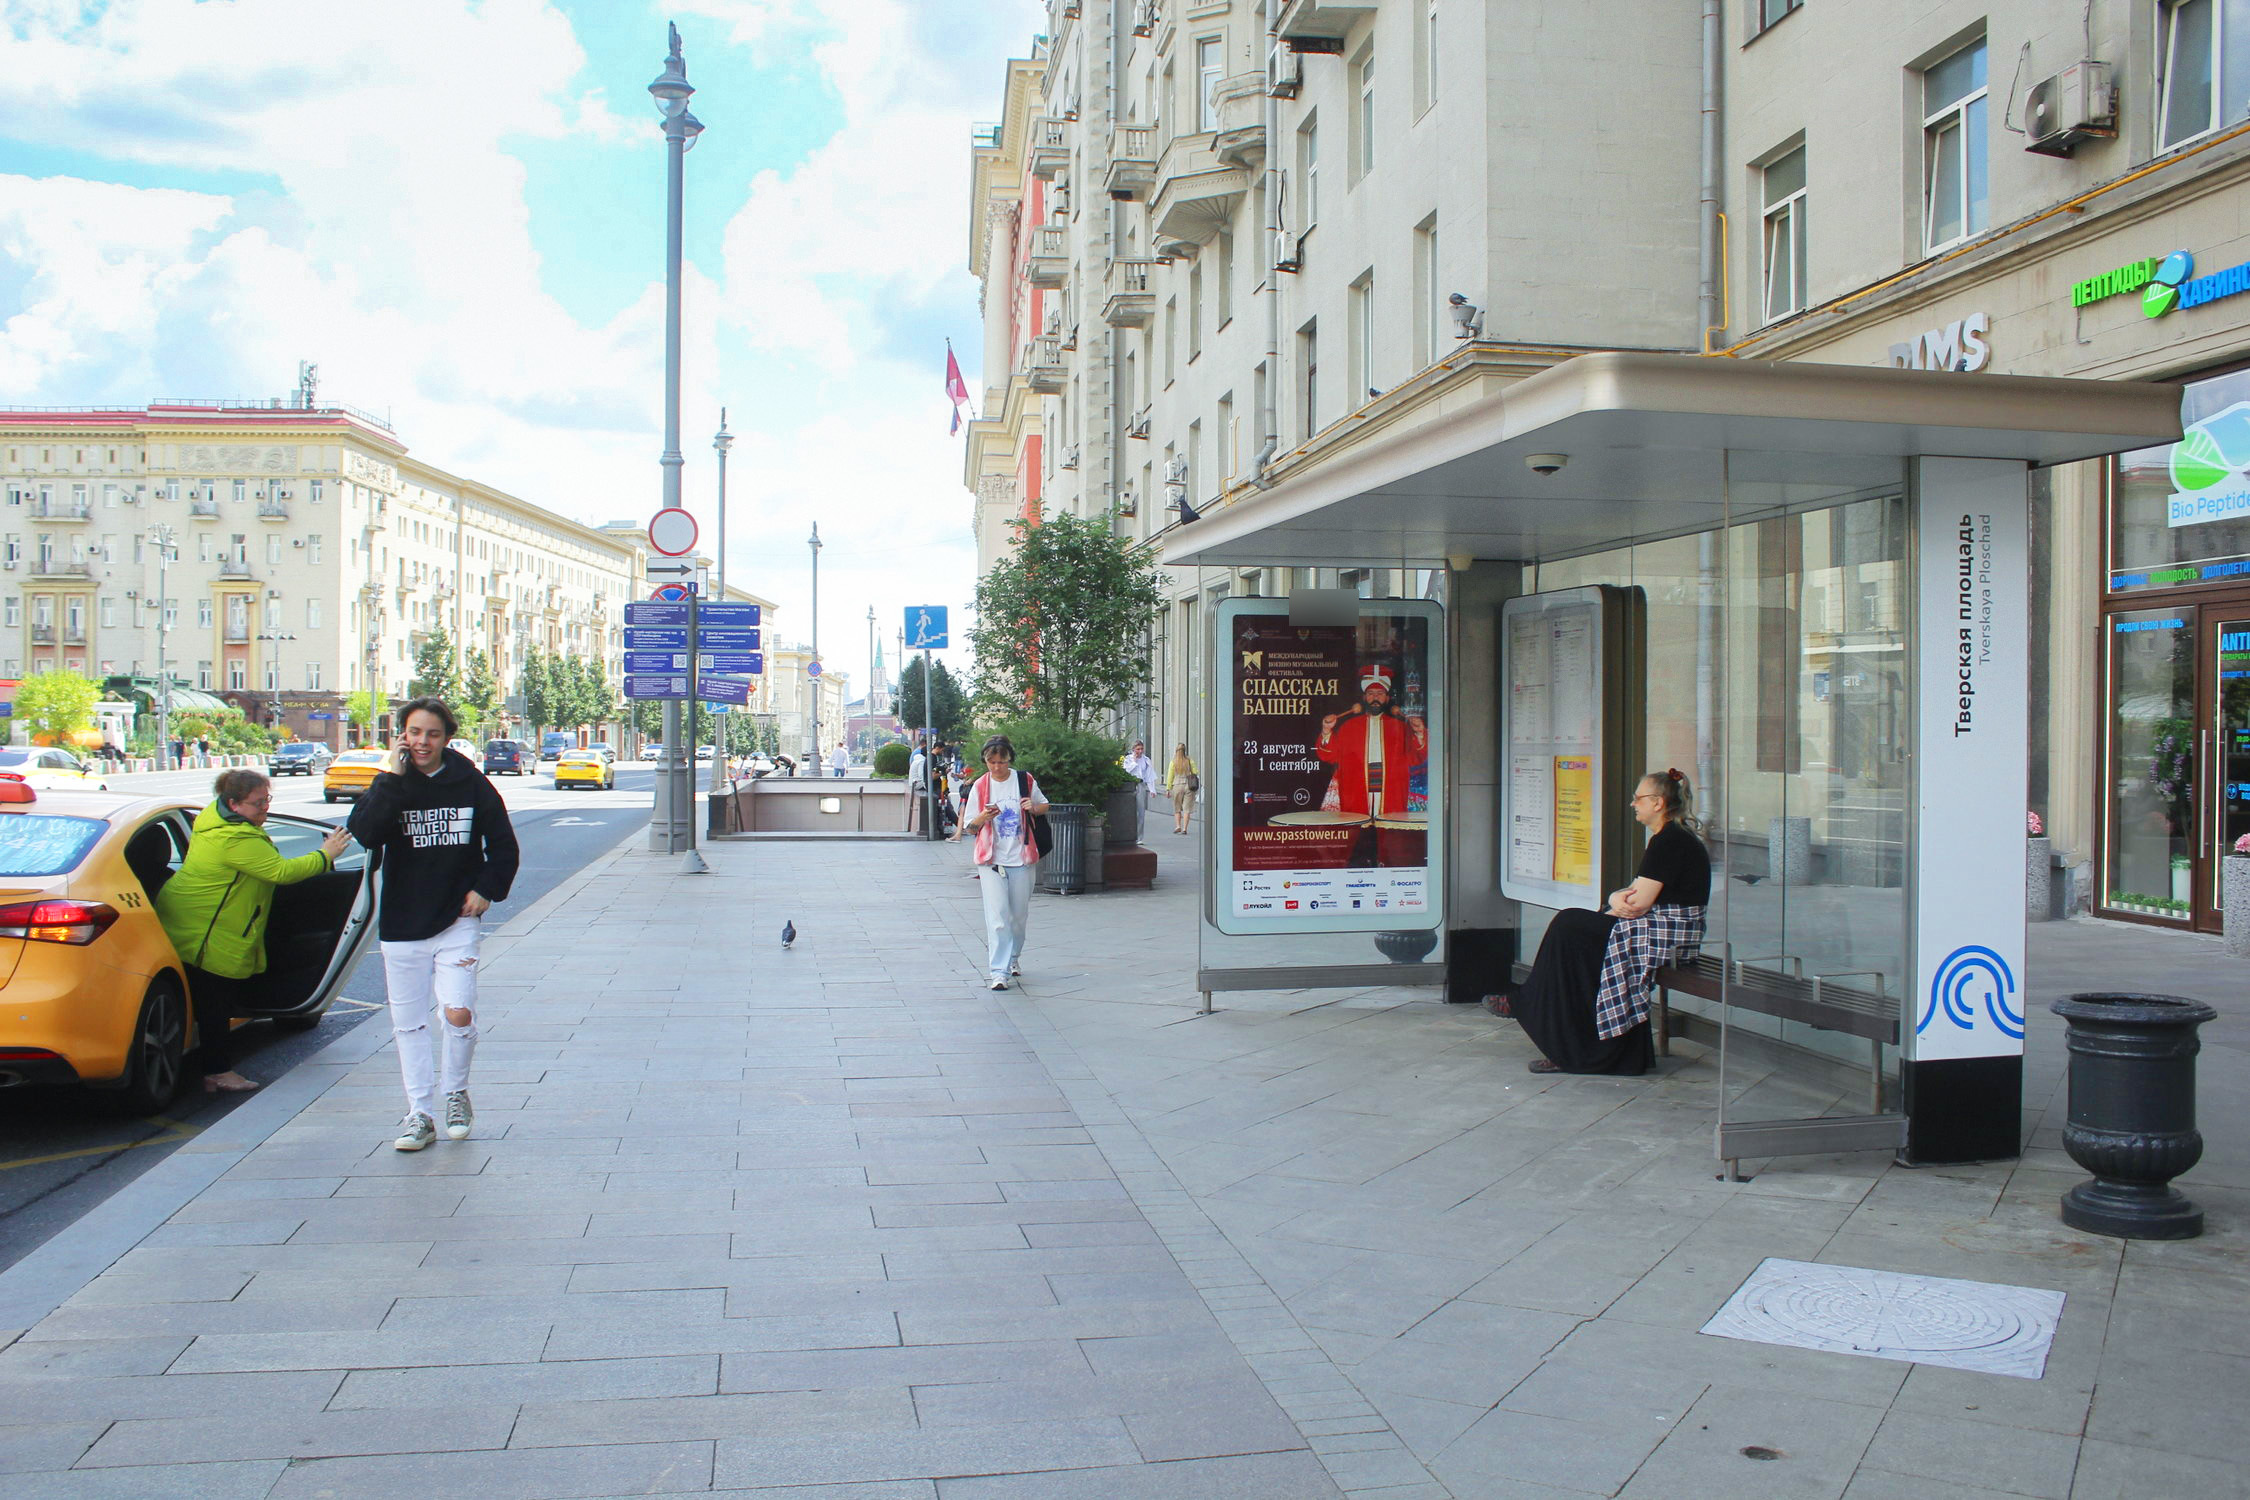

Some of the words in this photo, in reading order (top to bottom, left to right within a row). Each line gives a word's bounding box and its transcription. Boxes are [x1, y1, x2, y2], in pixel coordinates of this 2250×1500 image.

[2071, 257, 2157, 308] ПЕПТИДЫ
[2172, 501, 2194, 519] Bio
[1978, 513, 1991, 584] Ploschad
[1959, 513, 1975, 620] площадь
[1978, 589, 1993, 665] Tverskaya
[1242, 678, 1339, 696] СПАССКАЯ
[1955, 628, 1975, 738] Тверская
[1242, 698, 1311, 715] БАШНЯ
[1244, 740, 1258, 755] 23
[1262, 744, 1306, 757] августа
[1259, 757, 1264, 771] 1
[1269, 757, 1320, 774] сентября
[402, 820, 447, 836] LIMITED
[1243, 829, 1349, 844] www.spasstower.ru
[413, 832, 458, 848] EDITION
